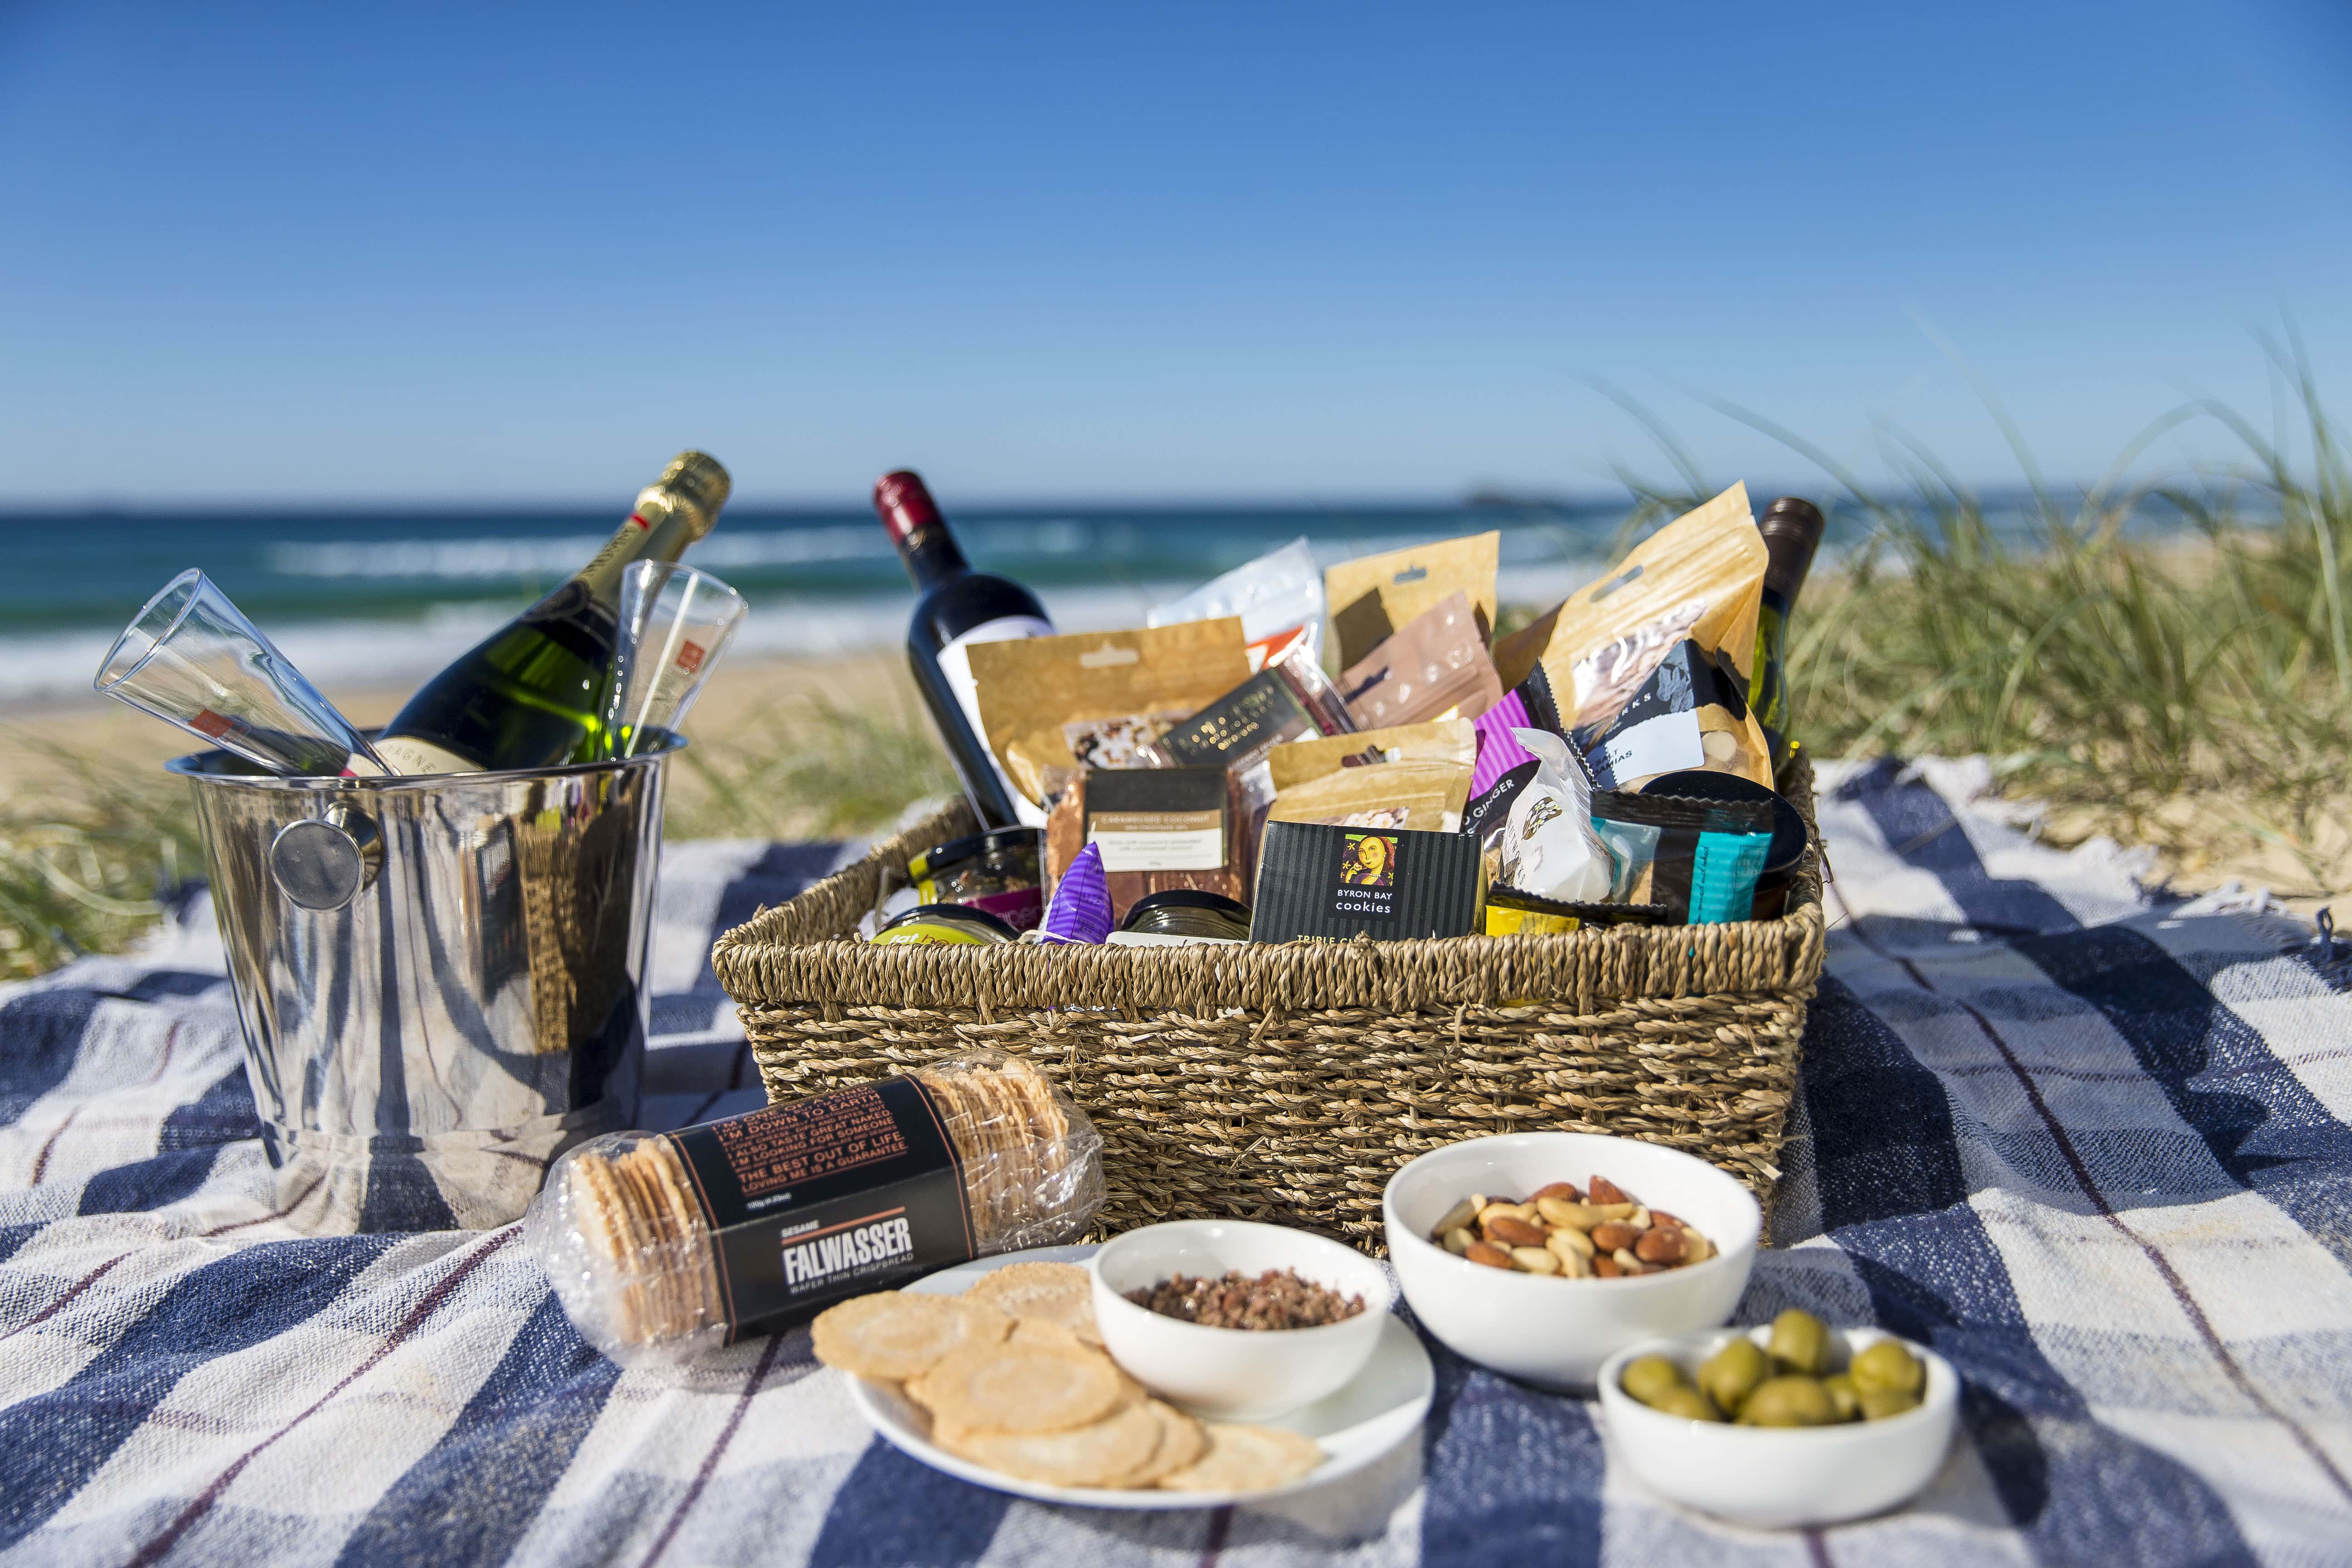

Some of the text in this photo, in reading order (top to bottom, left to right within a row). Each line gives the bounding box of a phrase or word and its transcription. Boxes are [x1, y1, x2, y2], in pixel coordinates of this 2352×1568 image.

[1472, 779, 1515, 818] GINGER
[1508, 819, 1526, 886] NUTWORKS
[1336, 900, 1391, 913] cookies
[1337, 889, 1393, 901] BYRON BAY
[1297, 934, 1335, 944] TRIPLE
[711, 1120, 737, 1132] I'M
[812, 1096, 824, 1104] A
[718, 1091, 881, 1142] I'M DOWN TO EARTH
[730, 1116, 895, 1168] I'M LOOKING FOR SOMEONE
[735, 1142, 768, 1157] ALSO
[770, 1132, 807, 1148] TASTE
[809, 1121, 847, 1137] GREAT
[737, 1167, 769, 1184] THE
[771, 1155, 810, 1175] BEST
[813, 1146, 844, 1163] OUT
[847, 1139, 868, 1153] OF
[741, 1173, 788, 1193] LOVING
[789, 1168, 808, 1180] ME
[810, 1163, 824, 1174] IS
[825, 1160, 836, 1170] A
[781, 1219, 820, 1238] SESAME
[782, 1217, 913, 1285] FALWASSER
[790, 1251, 915, 1294] WAFER THIN CRISPBREAD
